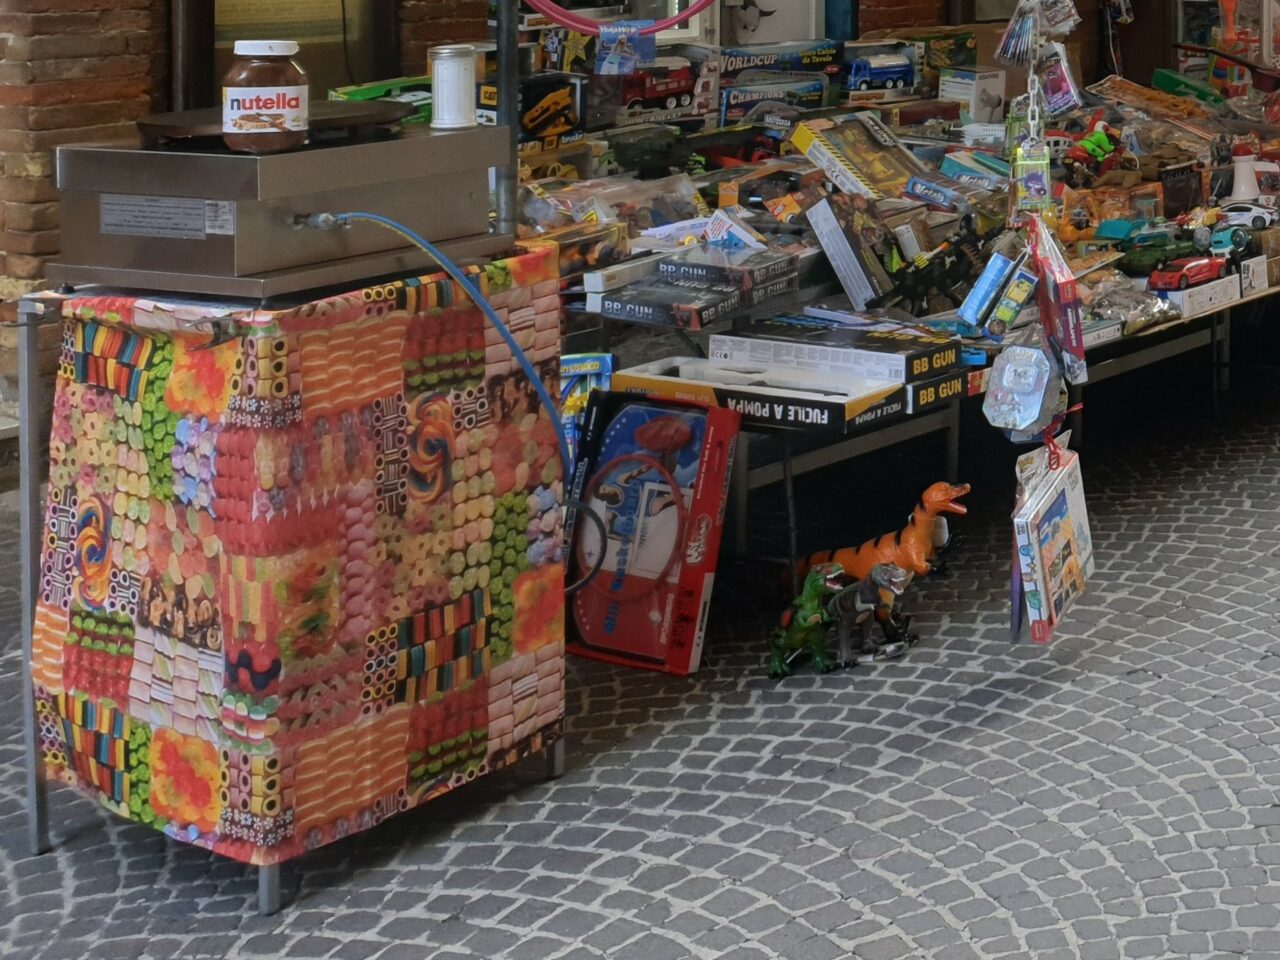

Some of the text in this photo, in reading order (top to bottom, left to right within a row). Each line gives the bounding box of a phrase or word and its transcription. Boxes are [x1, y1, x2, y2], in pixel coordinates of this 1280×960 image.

[230, 93, 300, 110] nutella
[605, 300, 652, 320] BB GUN
[702, 297, 738, 322] BB GUN
[913, 349, 956, 375] BB GUN
[920, 378, 962, 405] BB GUN
[727, 398, 829, 425] FUCILE A POMPA
